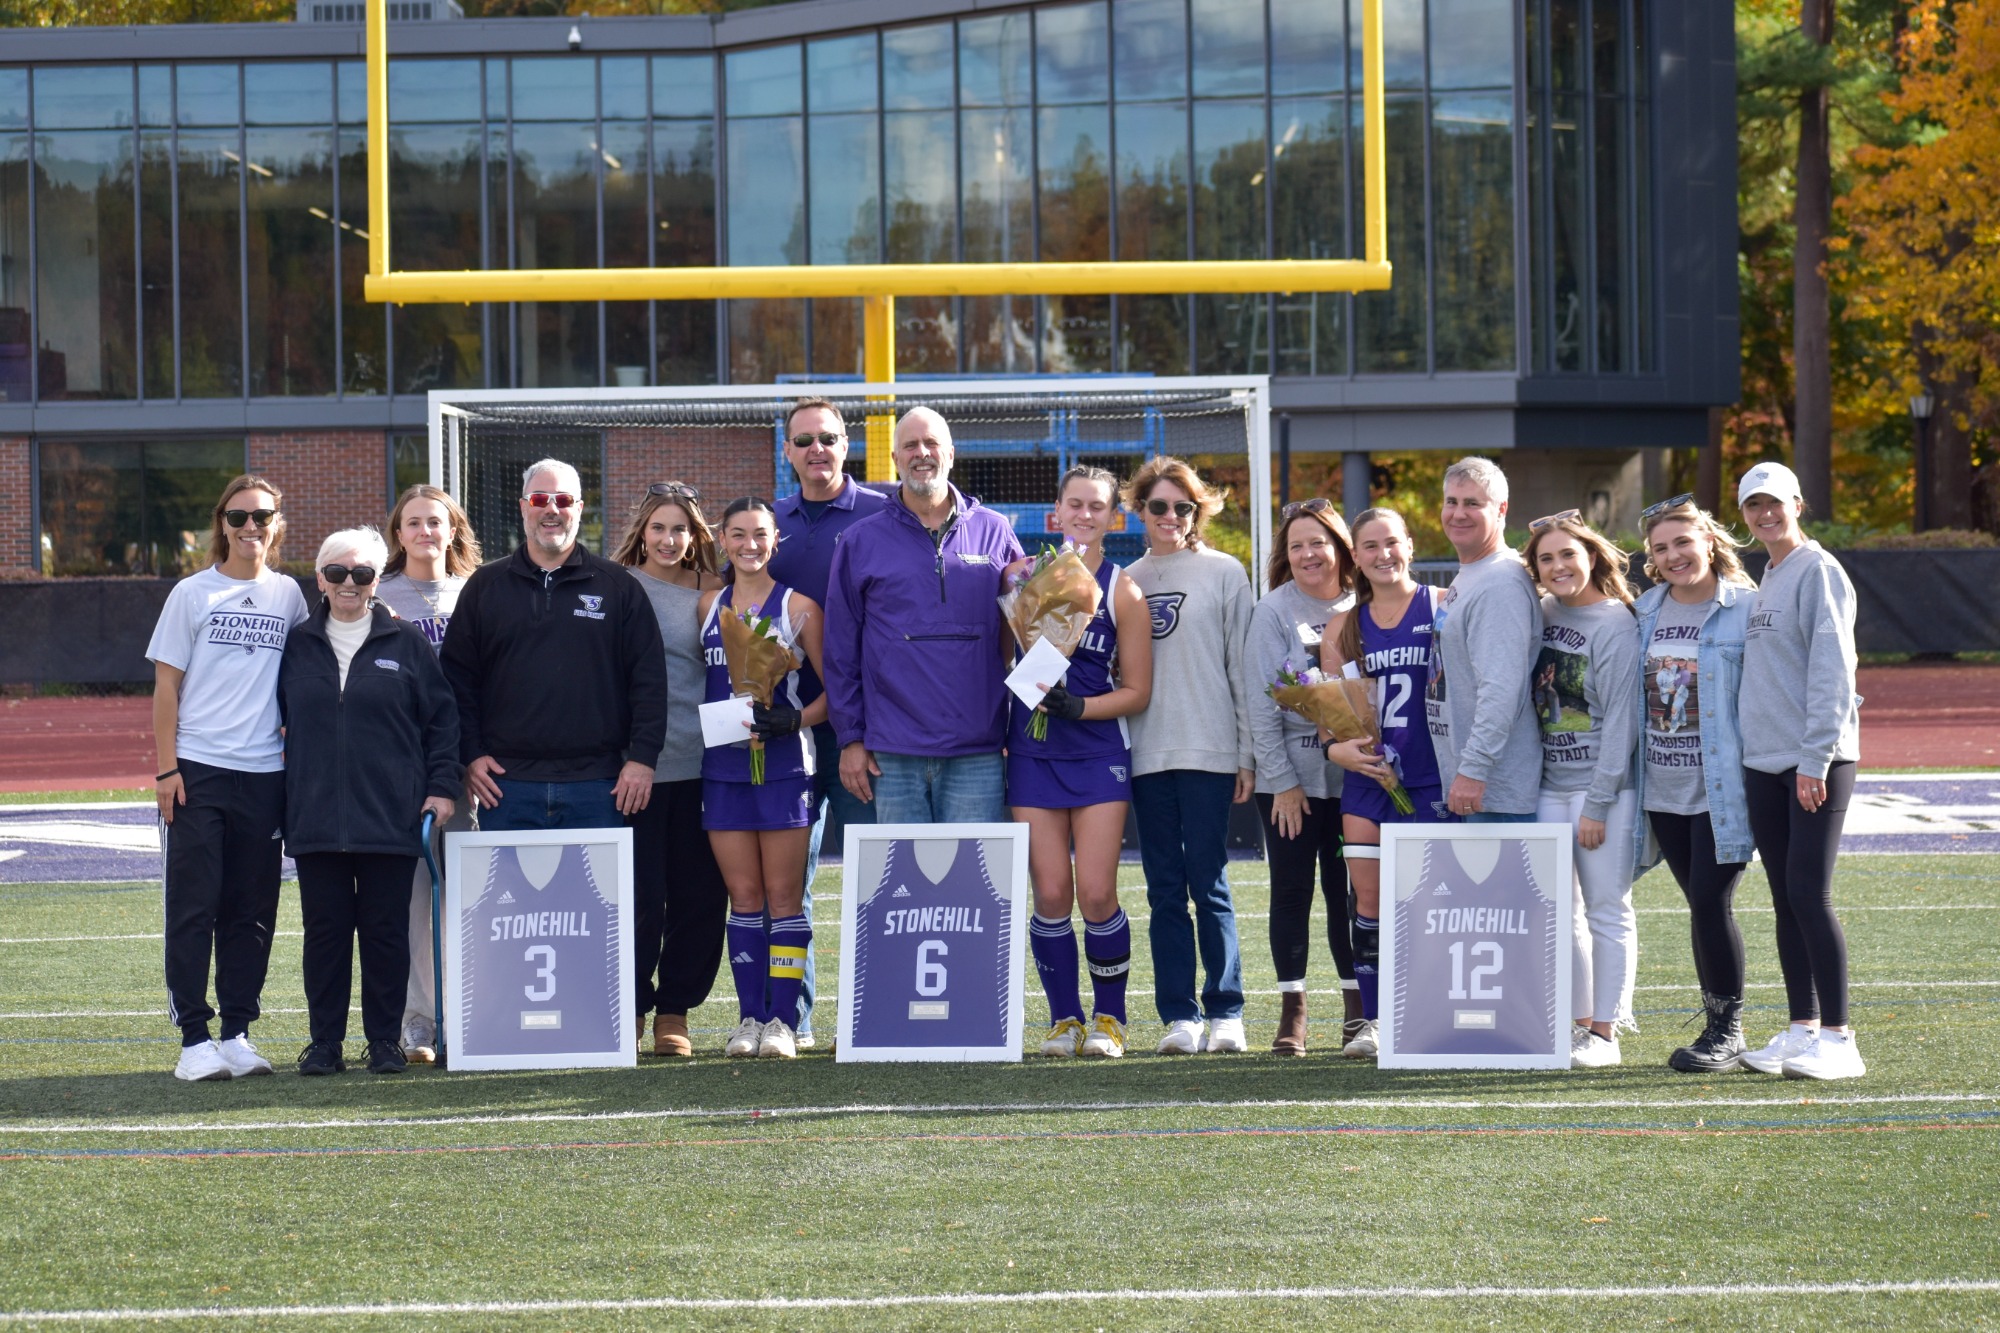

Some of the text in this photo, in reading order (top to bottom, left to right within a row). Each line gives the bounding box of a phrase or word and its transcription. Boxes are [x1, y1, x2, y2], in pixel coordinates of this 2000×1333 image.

[209, 628, 284, 647] FIELD HOCKEY
[210, 616, 285, 635] STONEHILL
[1412, 623, 1432, 632] NEC
[1542, 625, 1587, 650] SENIOR
[1654, 625, 1699, 642] SENI
[1365, 646, 1429, 673] ONEHIL
[1646, 747, 1703, 767] DARMSTA
[490, 911, 591, 941] STONEHILL
[883, 906, 984, 936] STONEHILL
[1424, 907, 1529, 935] STONEHILL
[524, 944, 556, 1002] 3
[915, 939, 949, 997] 6
[1089, 962, 1119, 975] APTAIN
[1448, 941, 1504, 1000] 12
